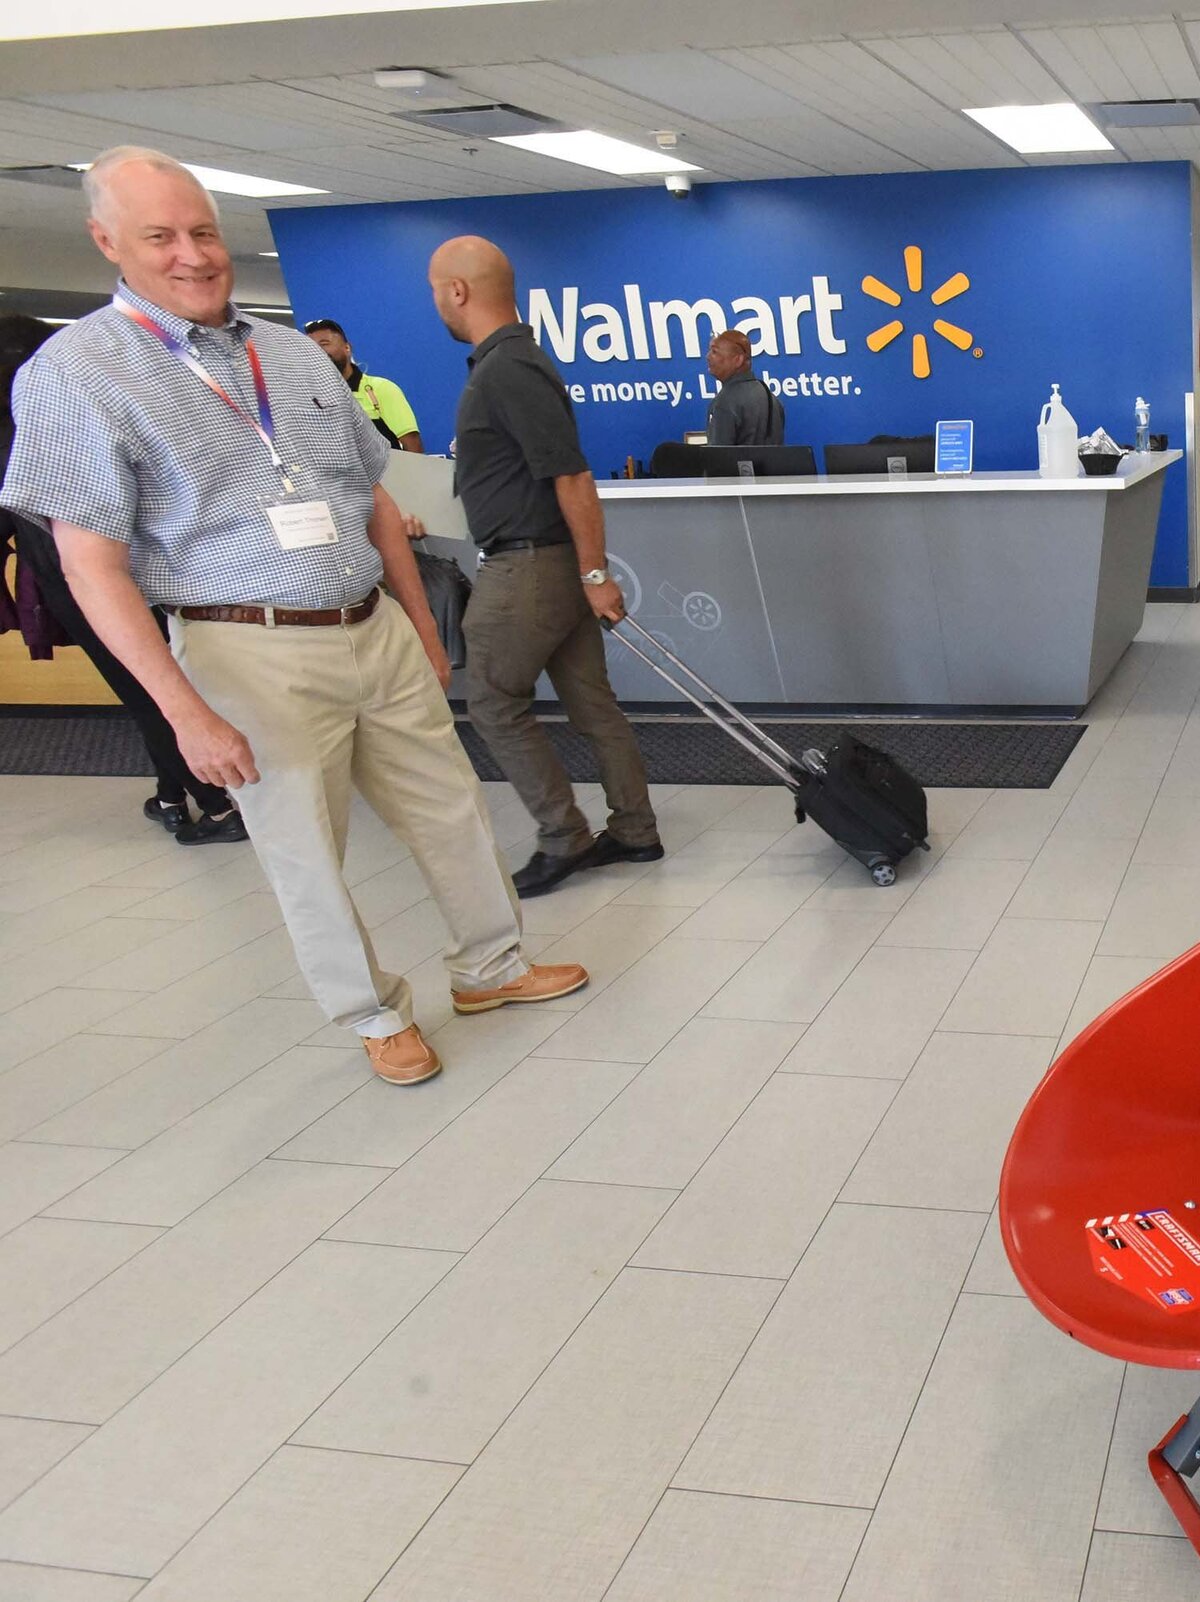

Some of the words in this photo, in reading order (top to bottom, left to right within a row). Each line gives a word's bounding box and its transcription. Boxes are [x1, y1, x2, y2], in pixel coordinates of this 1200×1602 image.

[514, 275, 847, 364] Walmart
[591, 380, 693, 407] money.
[762, 370, 862, 397] better.
